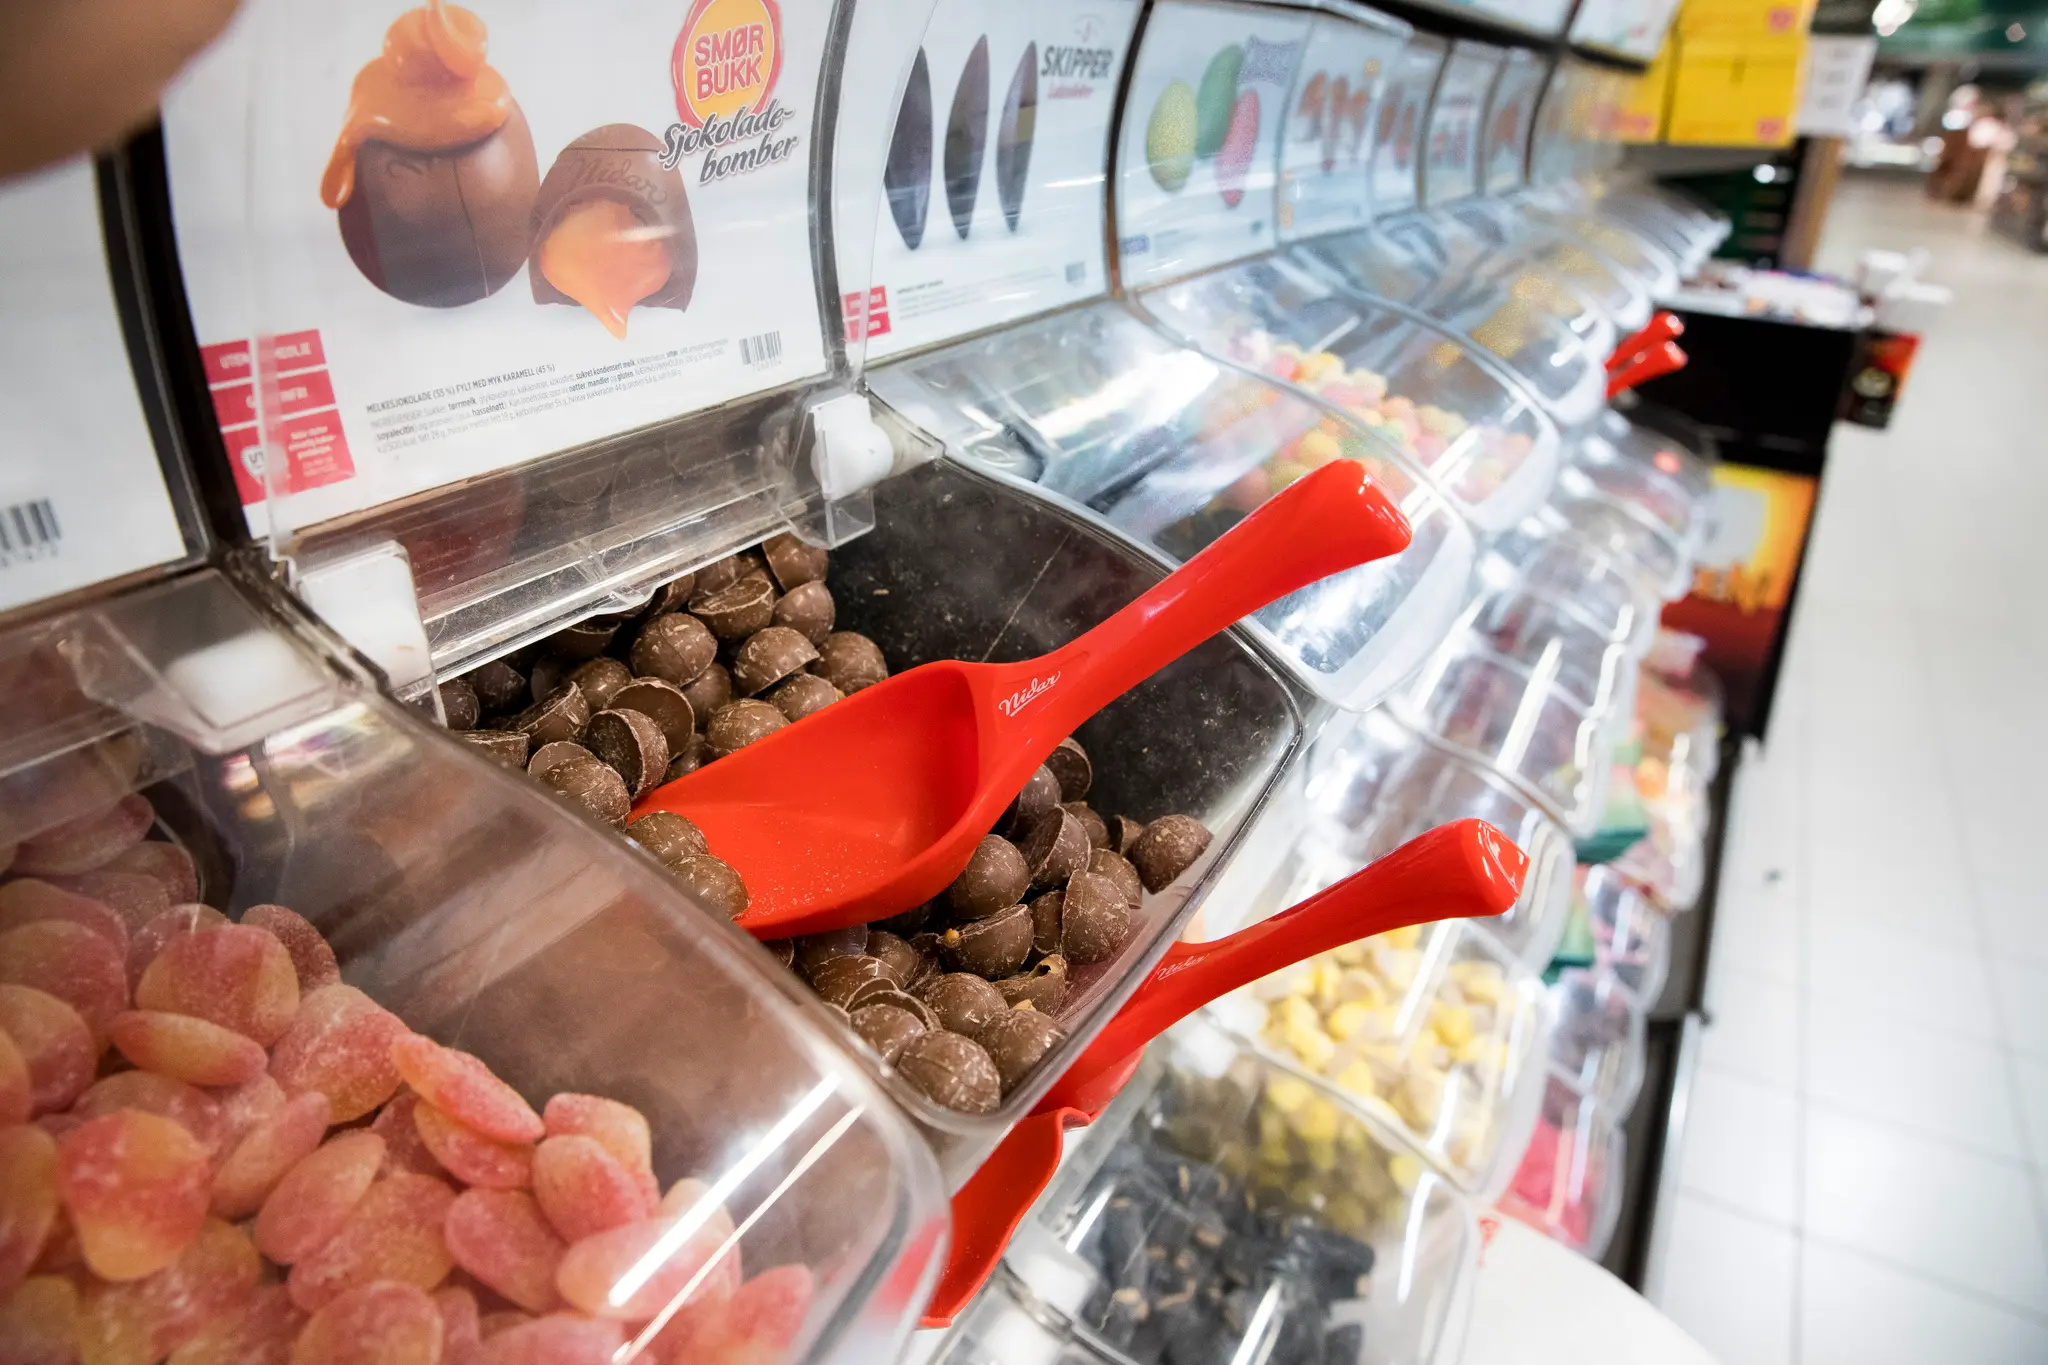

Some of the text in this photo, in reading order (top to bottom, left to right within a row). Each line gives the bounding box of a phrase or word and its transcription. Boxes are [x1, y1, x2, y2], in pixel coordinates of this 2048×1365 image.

[694, 24, 764, 67] SMØR
[1041, 45, 1113, 79] SKIPPER
[696, 54, 762, 100] BUKK
[658, 98, 794, 169] Sjokolade-
[699, 135, 797, 184] bomber
[366, 391, 432, 413] MELKESJOKOLADE
[472, 378, 487, 391] MED
[487, 374, 502, 387] MYK
[503, 368, 535, 383] KARAMELL
[998, 670, 1061, 717] Nidar
[1157, 952, 1210, 981] Nidar
